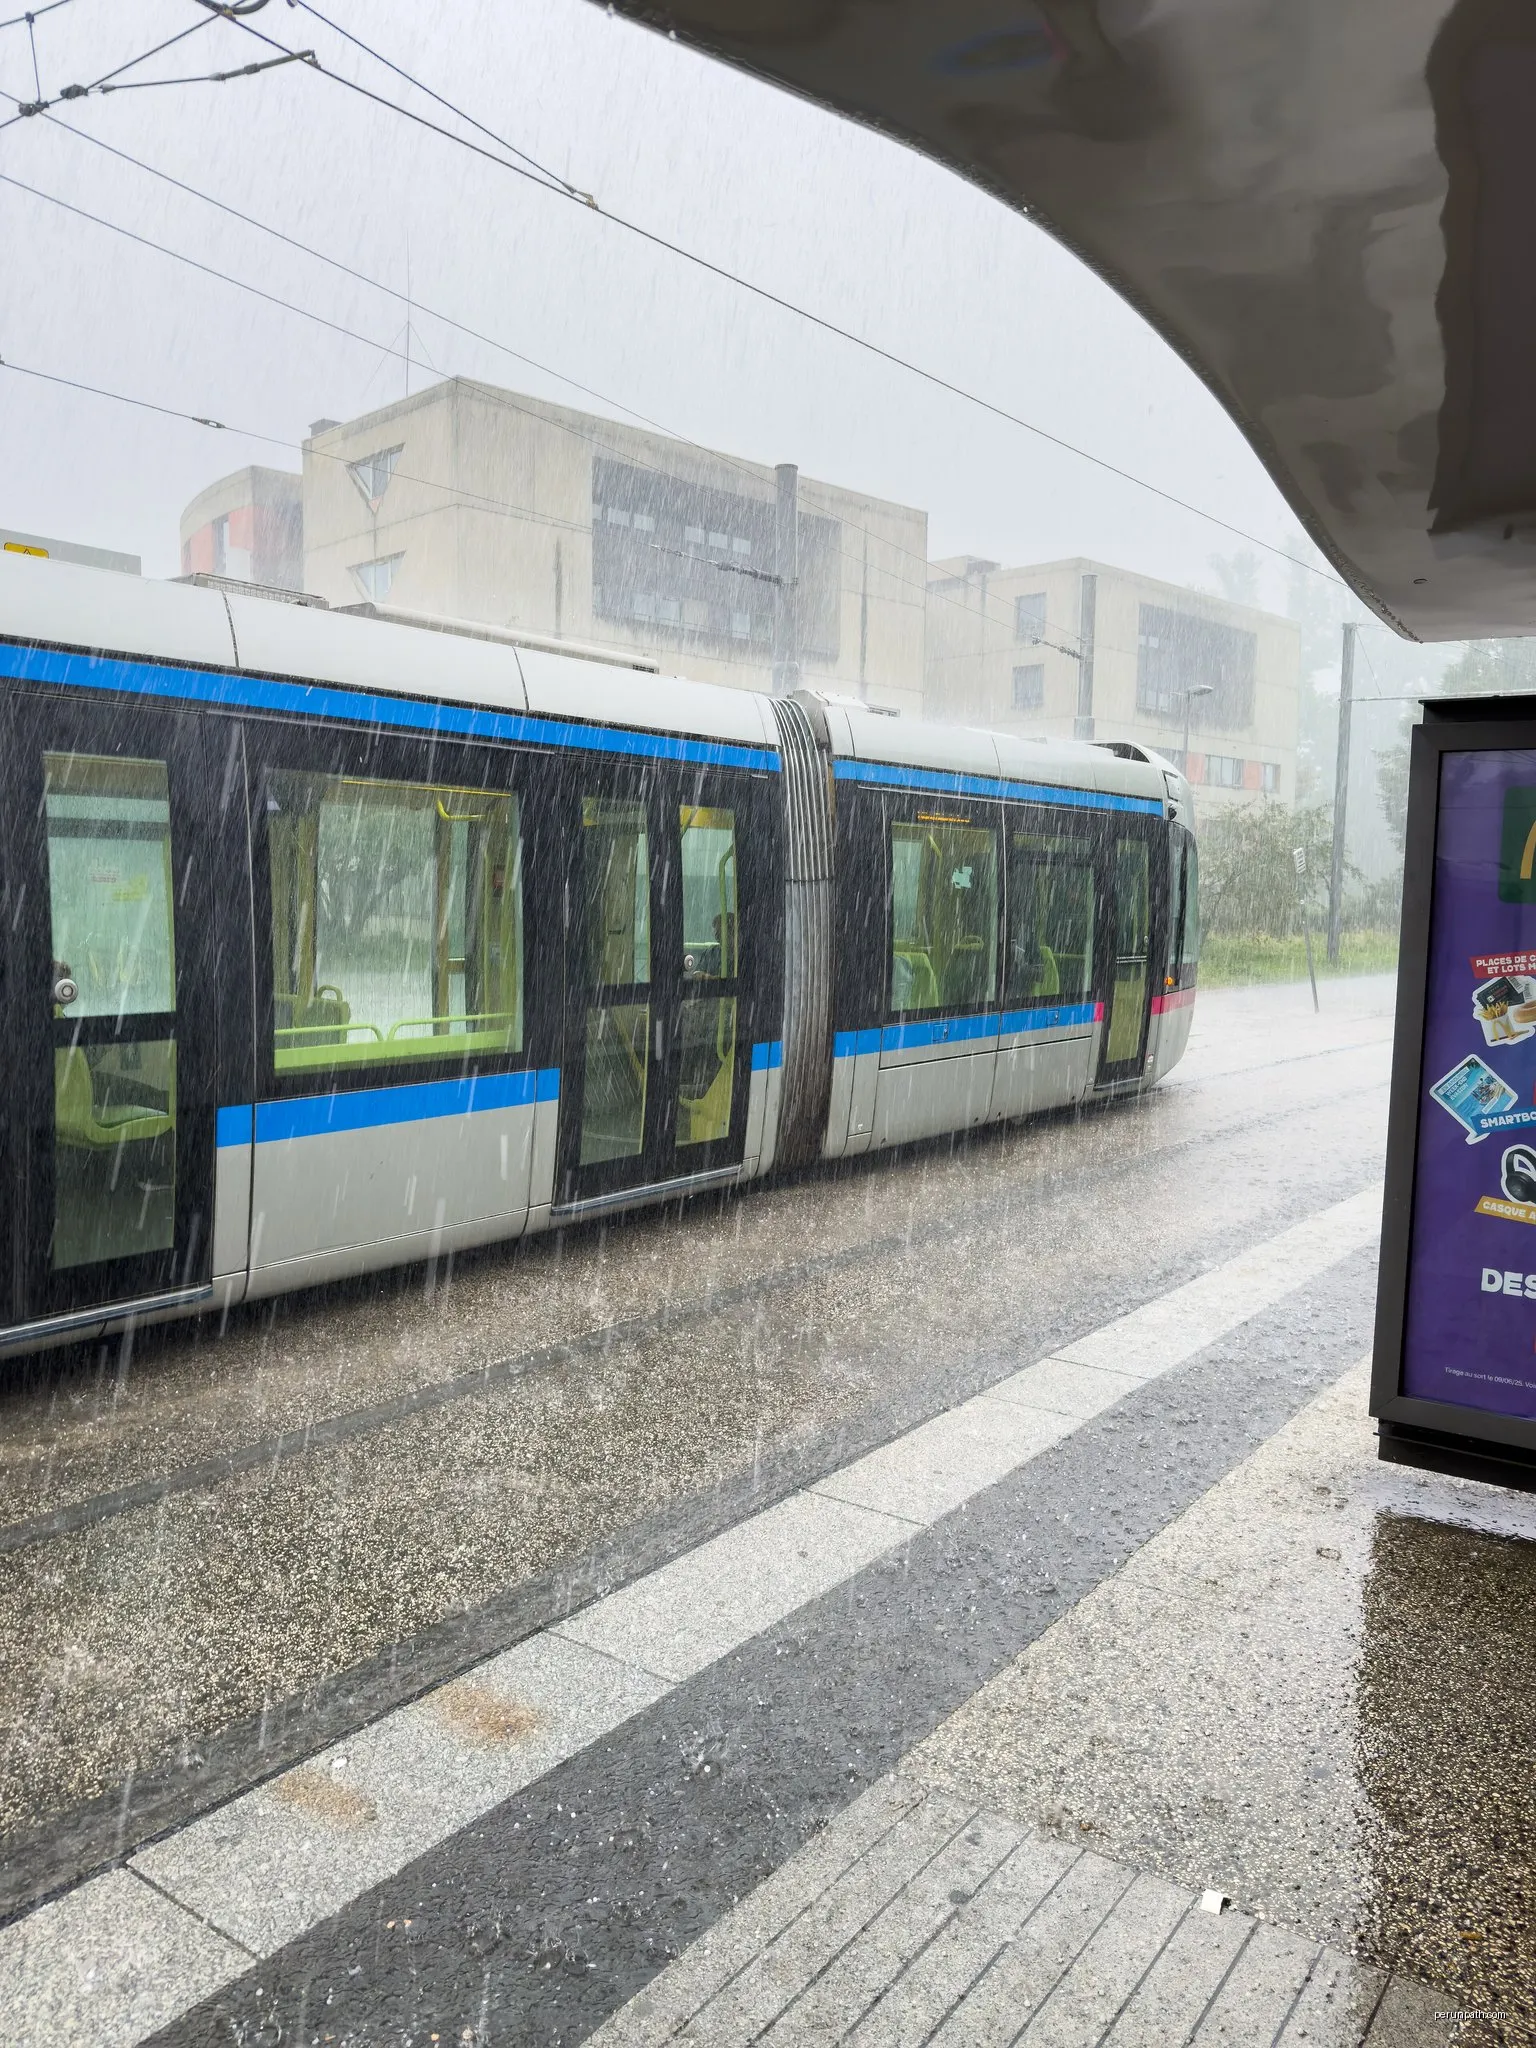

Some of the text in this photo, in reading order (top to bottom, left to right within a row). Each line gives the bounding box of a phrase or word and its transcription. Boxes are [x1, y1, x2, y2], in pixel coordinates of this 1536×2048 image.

[1475, 956, 1513, 968] PLACES
[1514, 955, 1528, 964] DE
[1487, 966, 1500, 974] ET
[1501, 963, 1526, 973] LOTS
[1482, 1201, 1527, 1218] CASQUE
[1481, 1267, 1536, 1300] DES
[1444, 1366, 1464, 1377] Tirage
